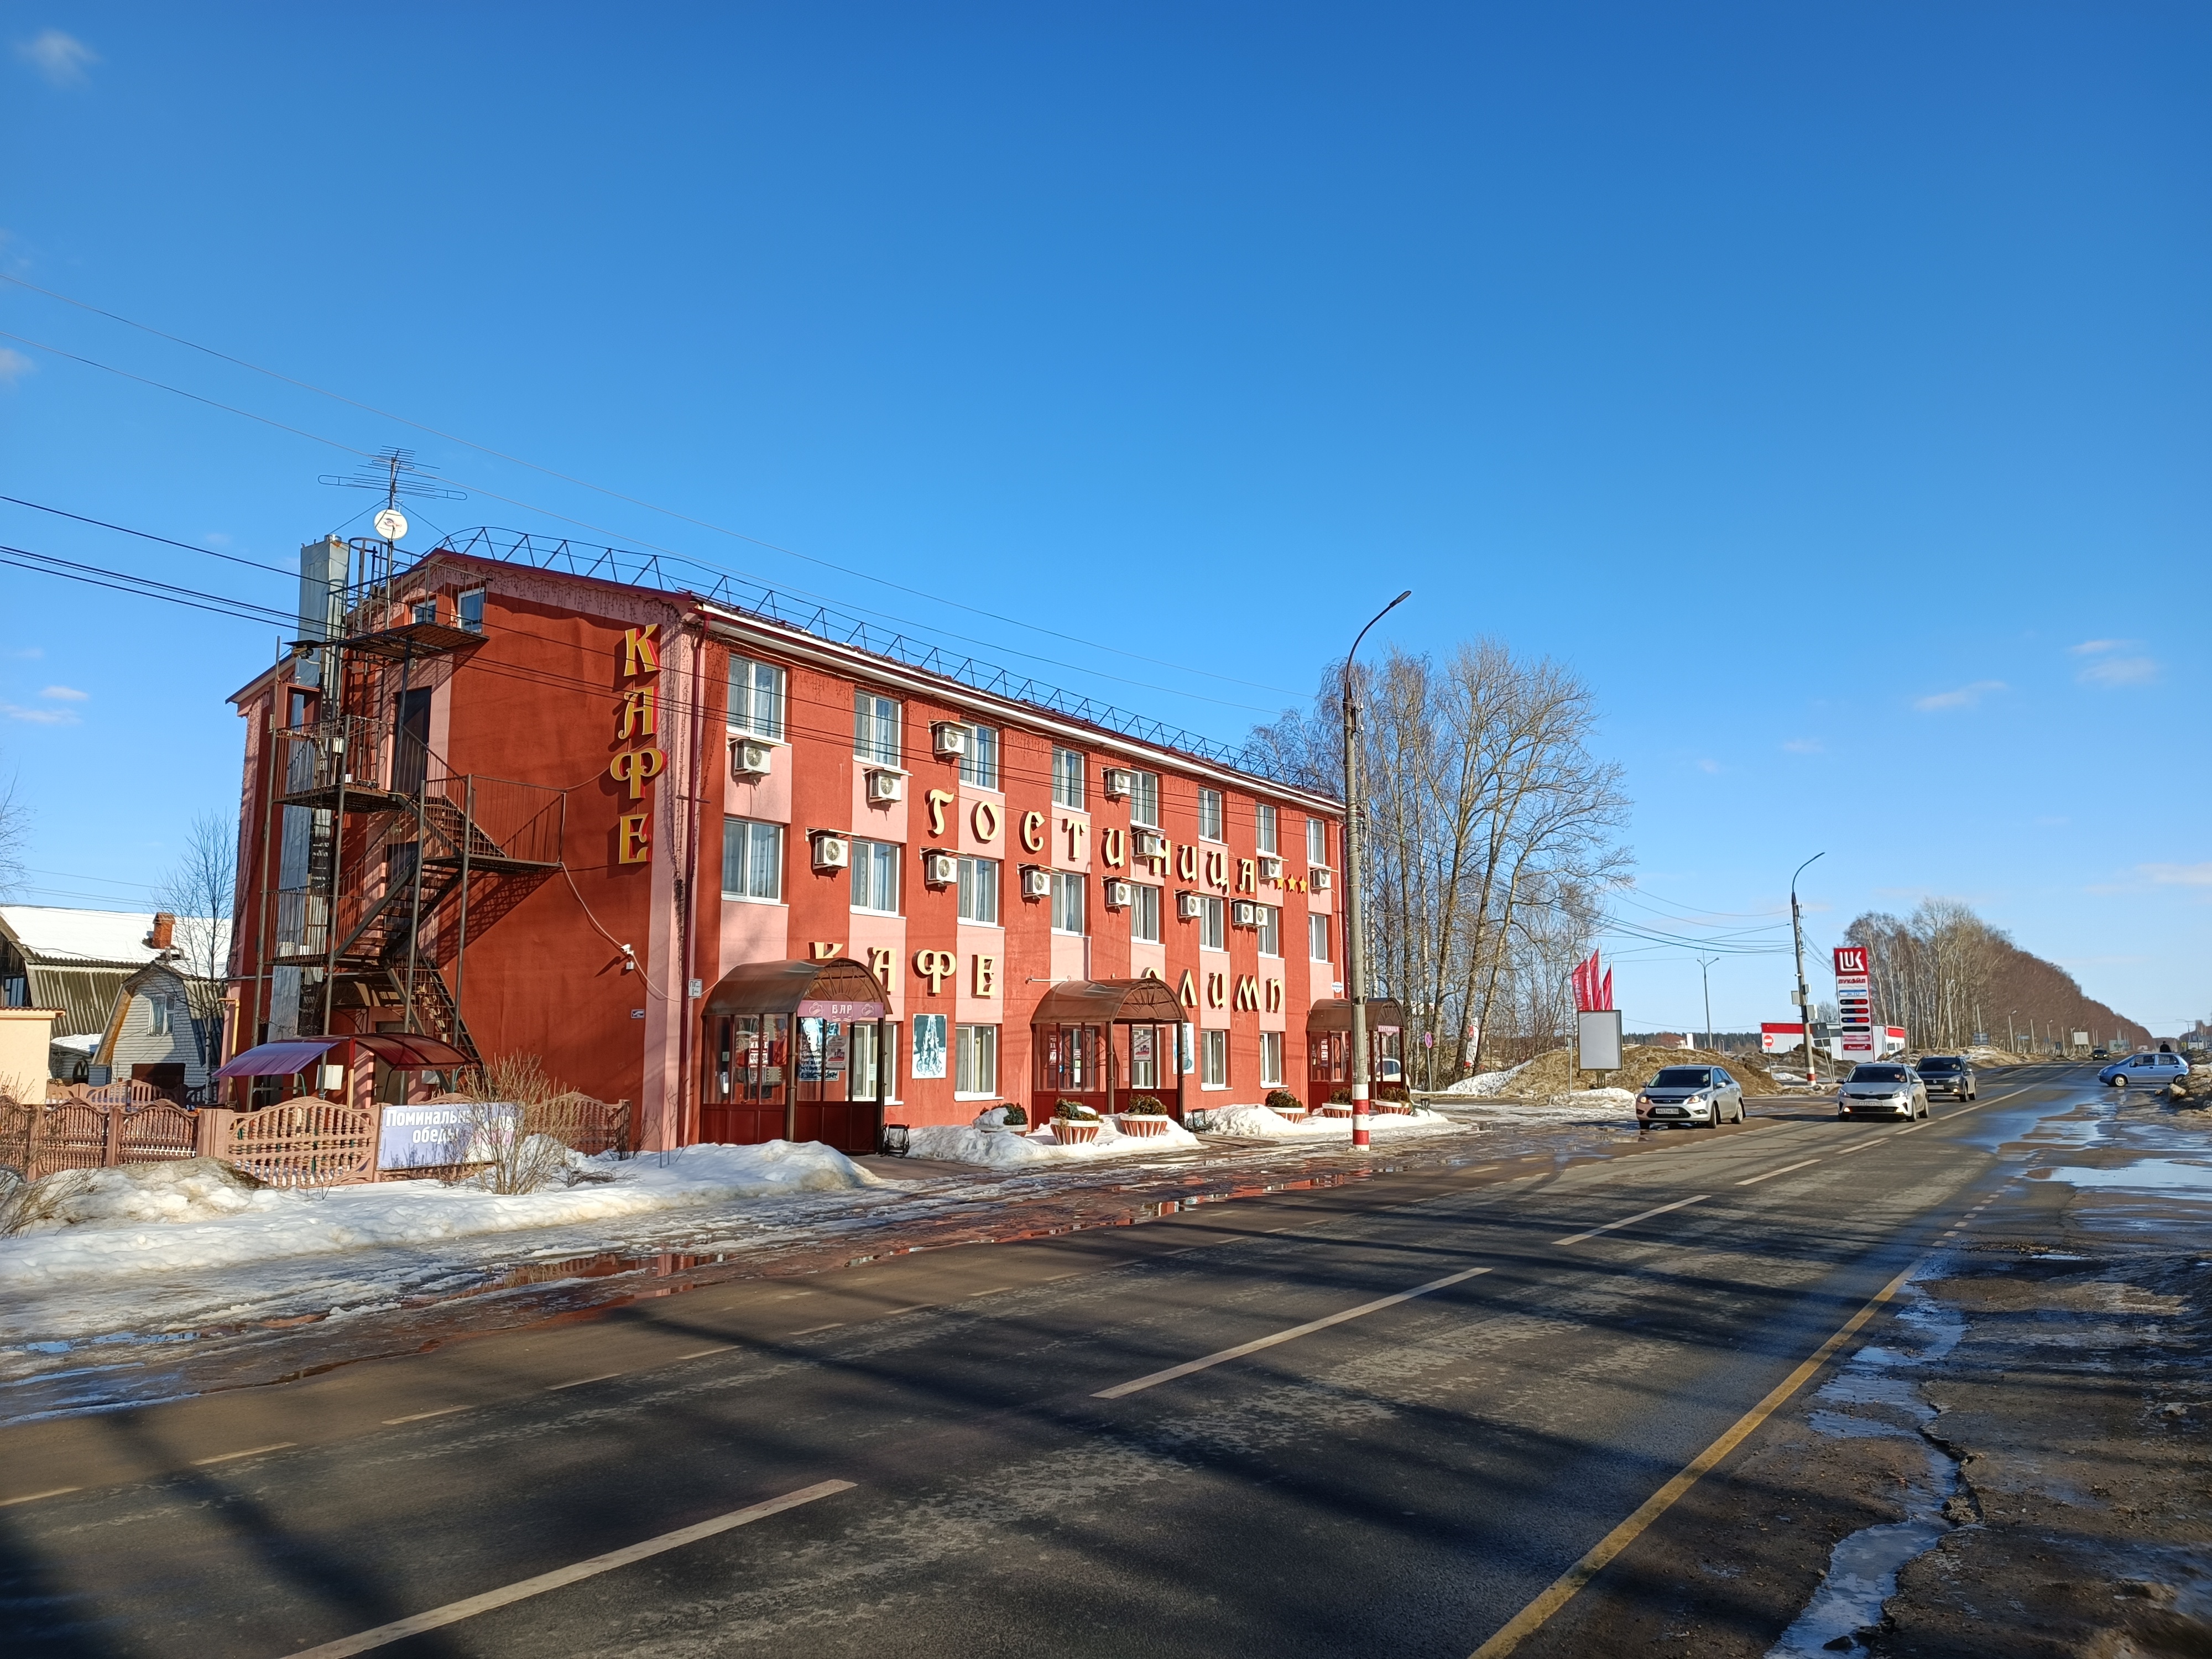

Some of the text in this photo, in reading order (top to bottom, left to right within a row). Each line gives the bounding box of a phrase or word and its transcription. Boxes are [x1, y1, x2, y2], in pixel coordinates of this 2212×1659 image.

[610, 623, 667, 864] КАФЕ
[929, 789, 1255, 894] ГОСТИНИЦА
[832, 1004, 852, 1014] БАР
[1144, 967, 1284, 1011] ЛИМП
[386, 1109, 473, 1126] Поминальн
